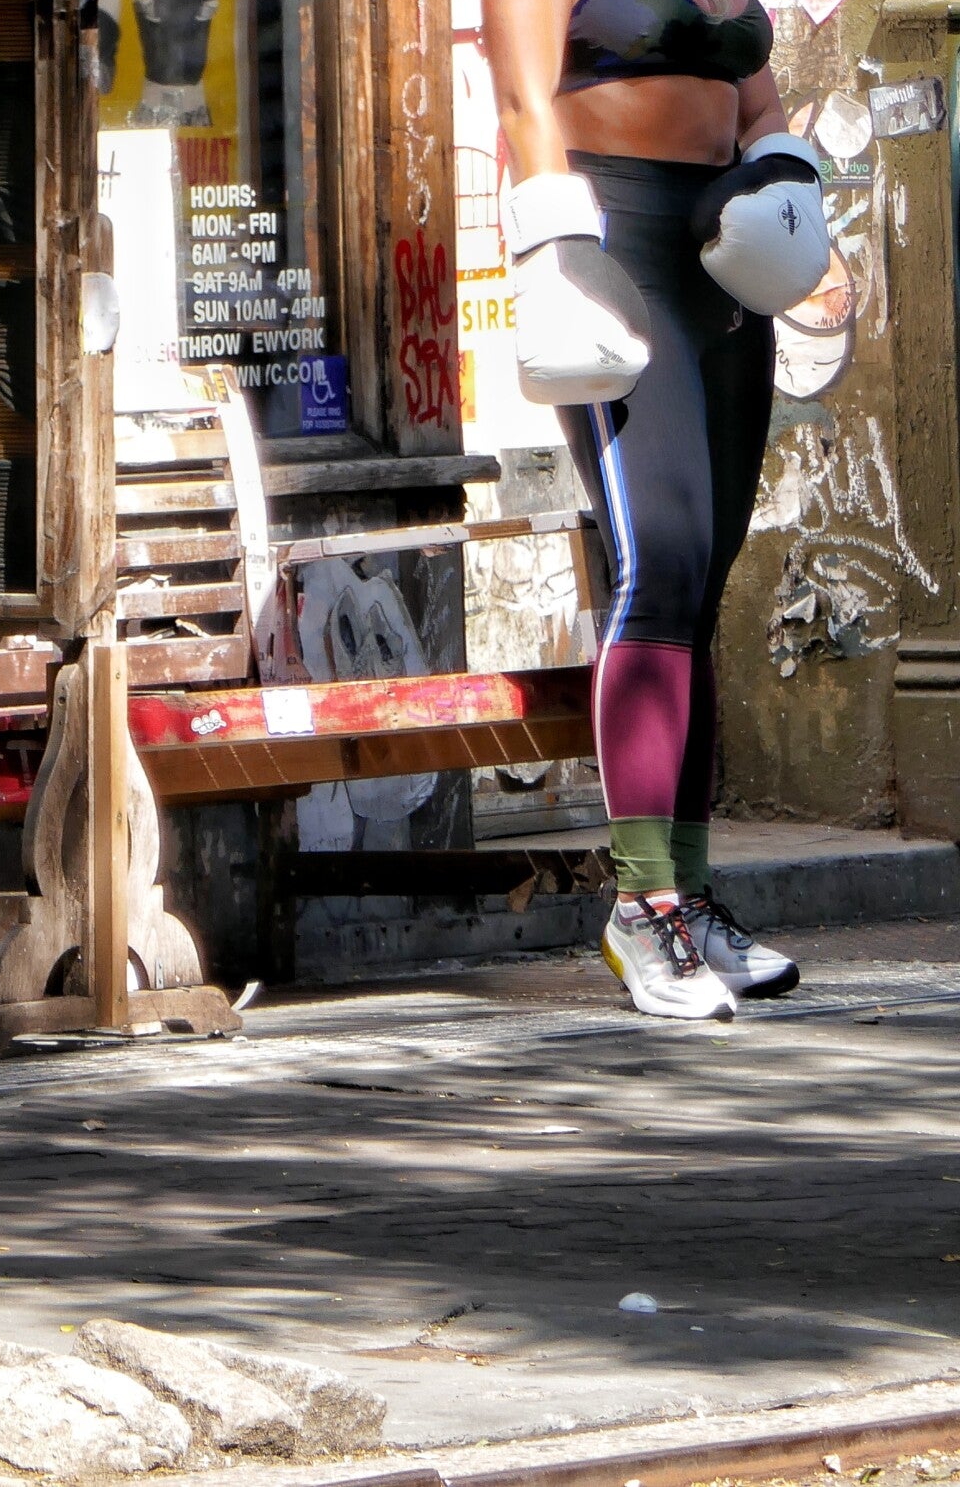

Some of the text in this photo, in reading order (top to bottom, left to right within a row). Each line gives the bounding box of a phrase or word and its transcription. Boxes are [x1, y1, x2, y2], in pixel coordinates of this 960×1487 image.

[190, 185, 256, 209] HOURS:
[249, 212, 277, 234] FRI
[192, 243, 227, 265] 6AM
[242, 241, 277, 263] 9PM
[193, 271, 227, 294] SAT
[276, 268, 311, 290] 4PM
[193, 299, 230, 324] SUN
[235, 297, 277, 321] 10AM
[291, 296, 325, 319] 4PM
